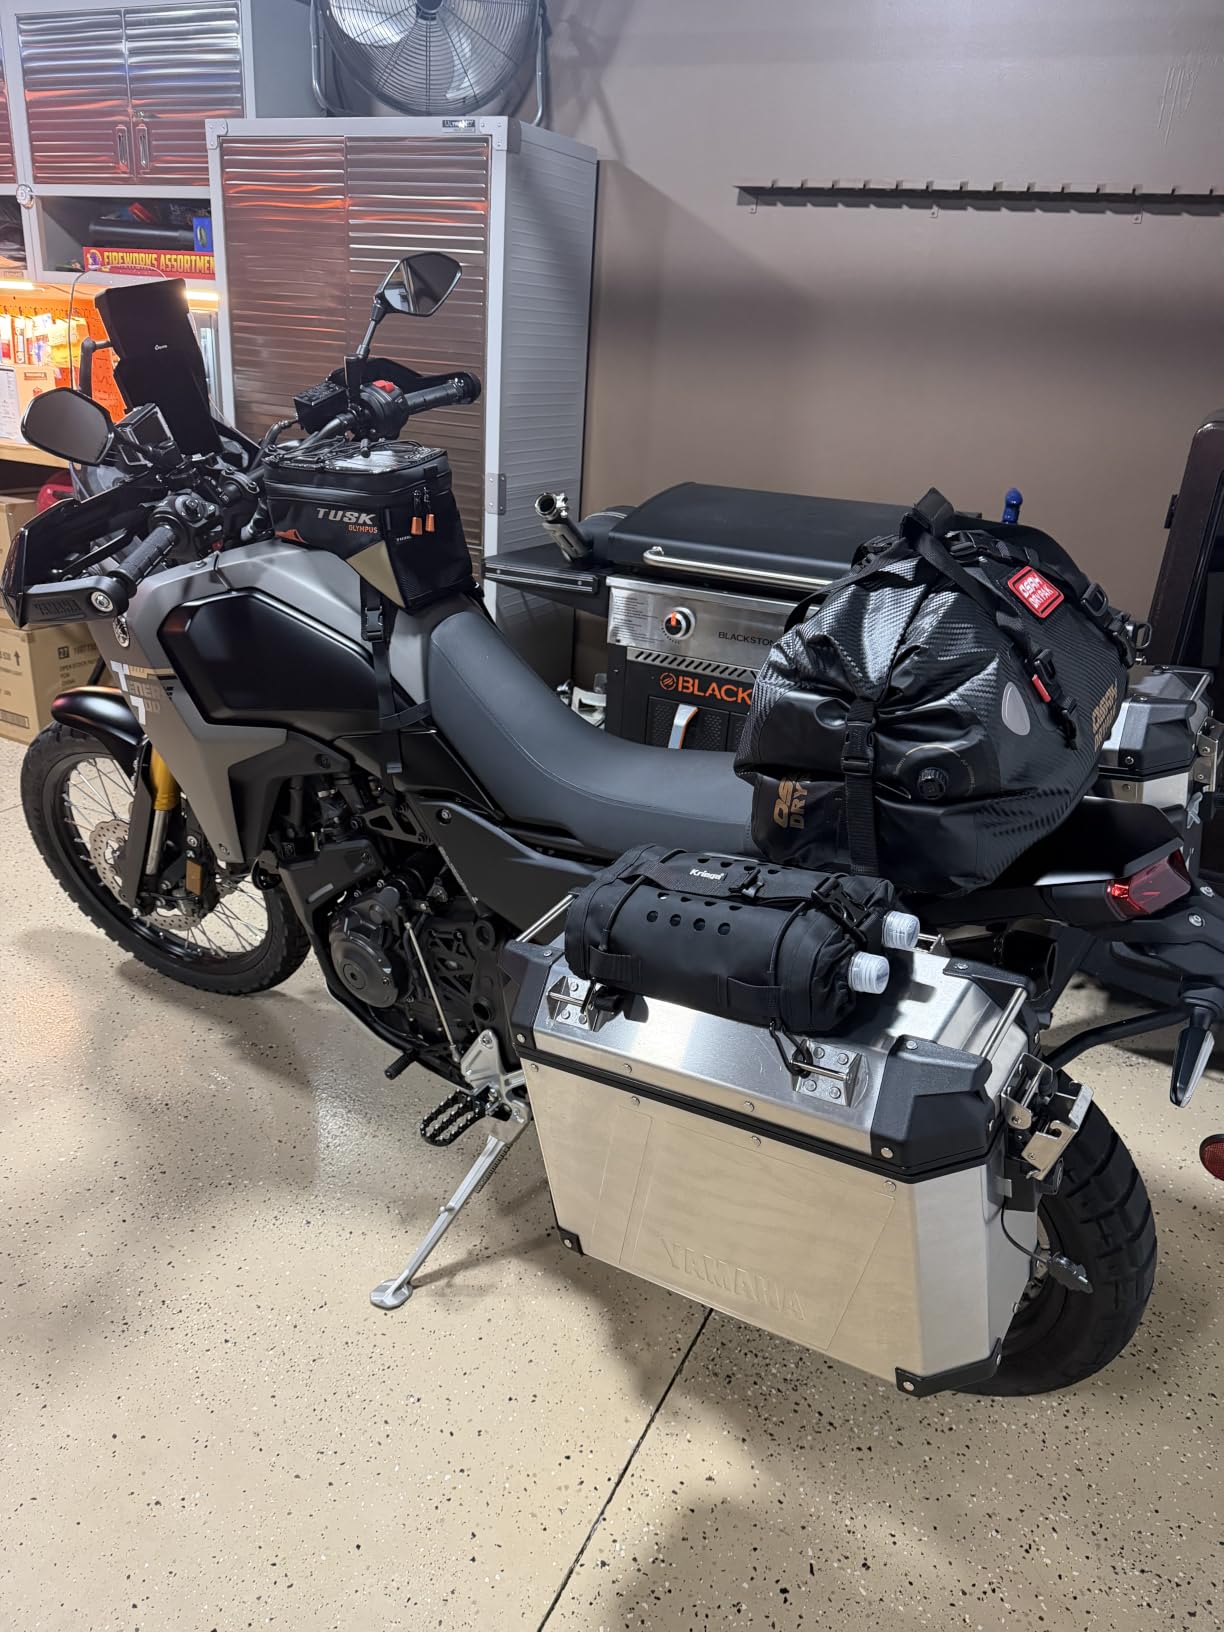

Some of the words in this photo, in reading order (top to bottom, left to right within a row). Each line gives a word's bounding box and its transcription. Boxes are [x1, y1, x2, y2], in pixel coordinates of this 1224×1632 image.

[103, 251, 158, 269] FIREWORKS
[316, 507, 376, 525] TUSK
[348, 524, 378, 534] OLYMPUS
[655, 1234, 806, 1321] YAMAHA
